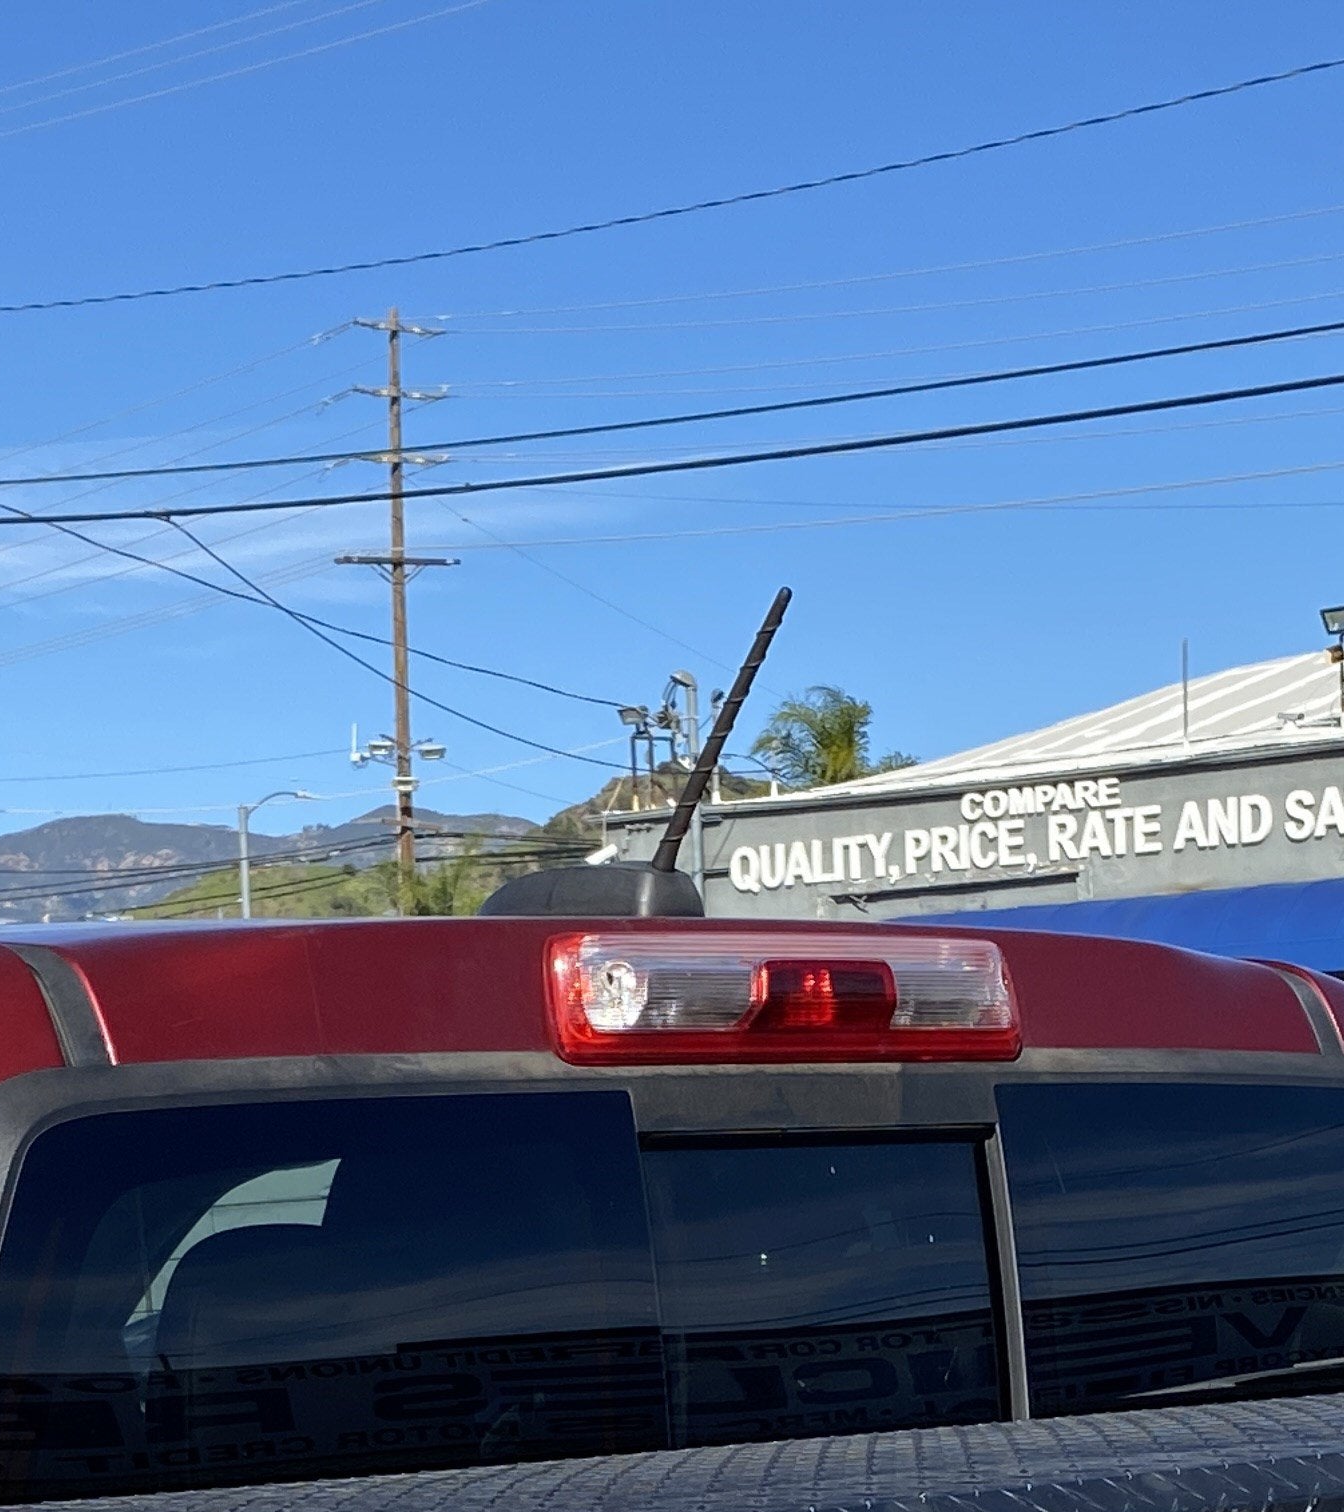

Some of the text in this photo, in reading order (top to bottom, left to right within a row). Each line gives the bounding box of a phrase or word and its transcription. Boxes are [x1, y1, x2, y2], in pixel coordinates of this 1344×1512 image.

[960, 778, 1121, 821] COMPARE
[729, 832, 900, 894] QUALITY,
[904, 819, 1038, 873] PRICE,
[1047, 804, 1163, 862] RATE
[1173, 794, 1274, 851] AND
